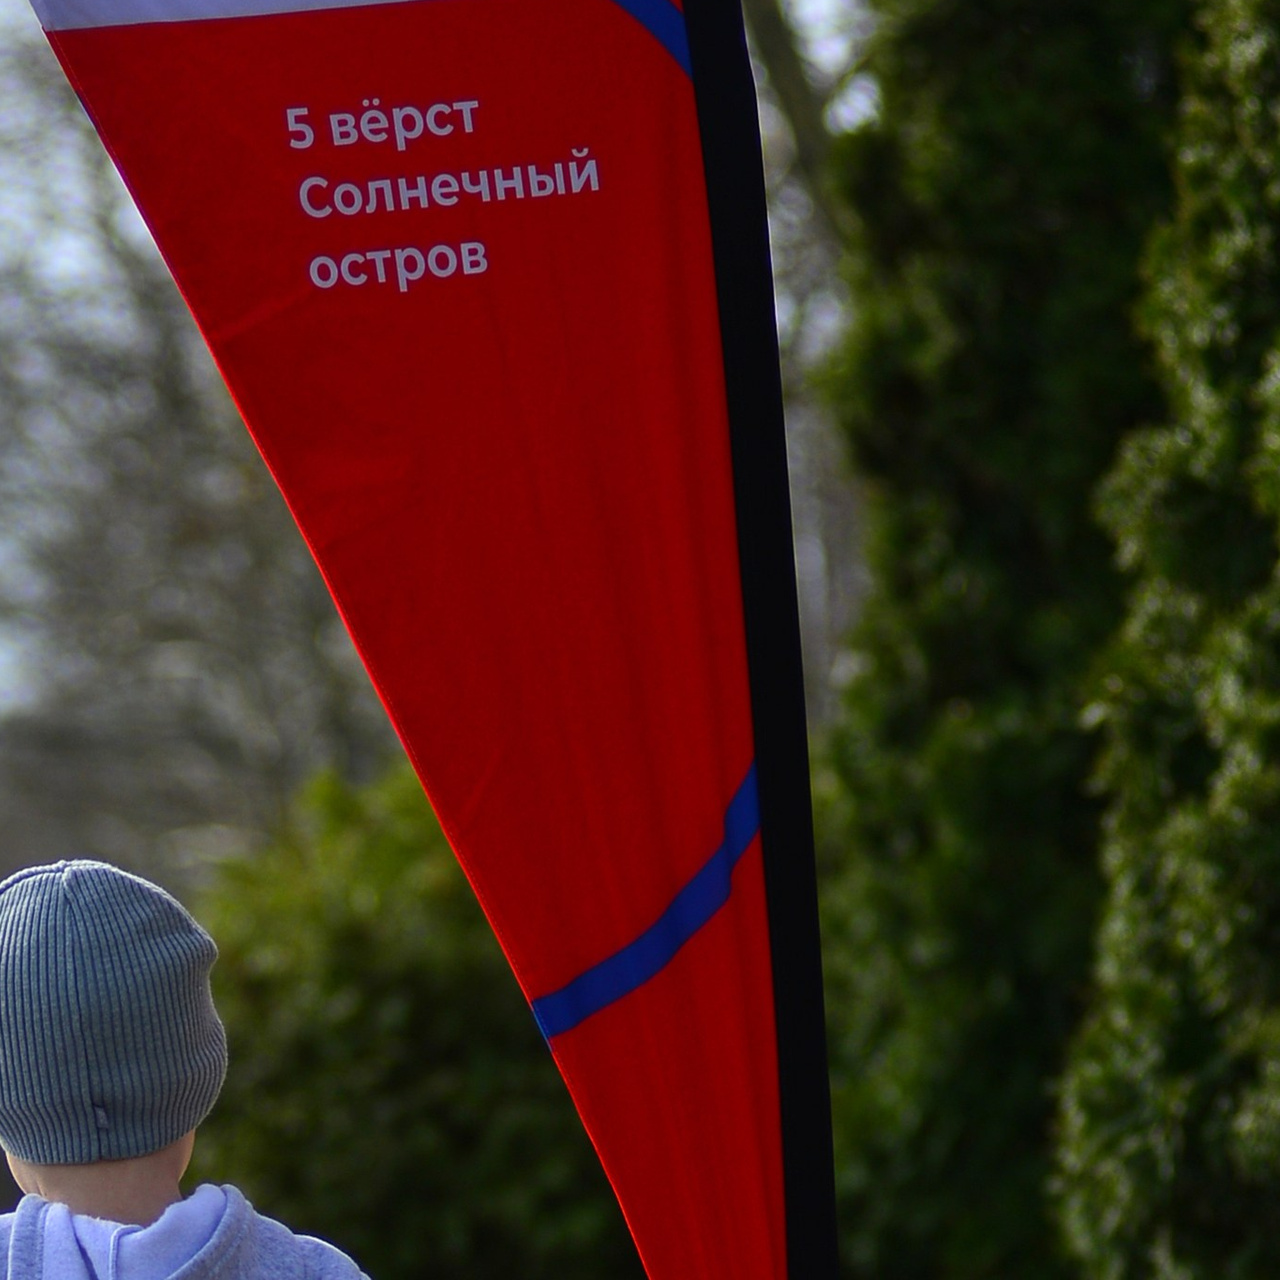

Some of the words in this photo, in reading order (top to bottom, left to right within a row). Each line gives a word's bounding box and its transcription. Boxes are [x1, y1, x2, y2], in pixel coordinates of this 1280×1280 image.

[286, 107, 315, 150] 5
[328, 98, 480, 152] вёрст
[298, 147, 600, 219] Солнечный
[308, 241, 489, 293] остров
